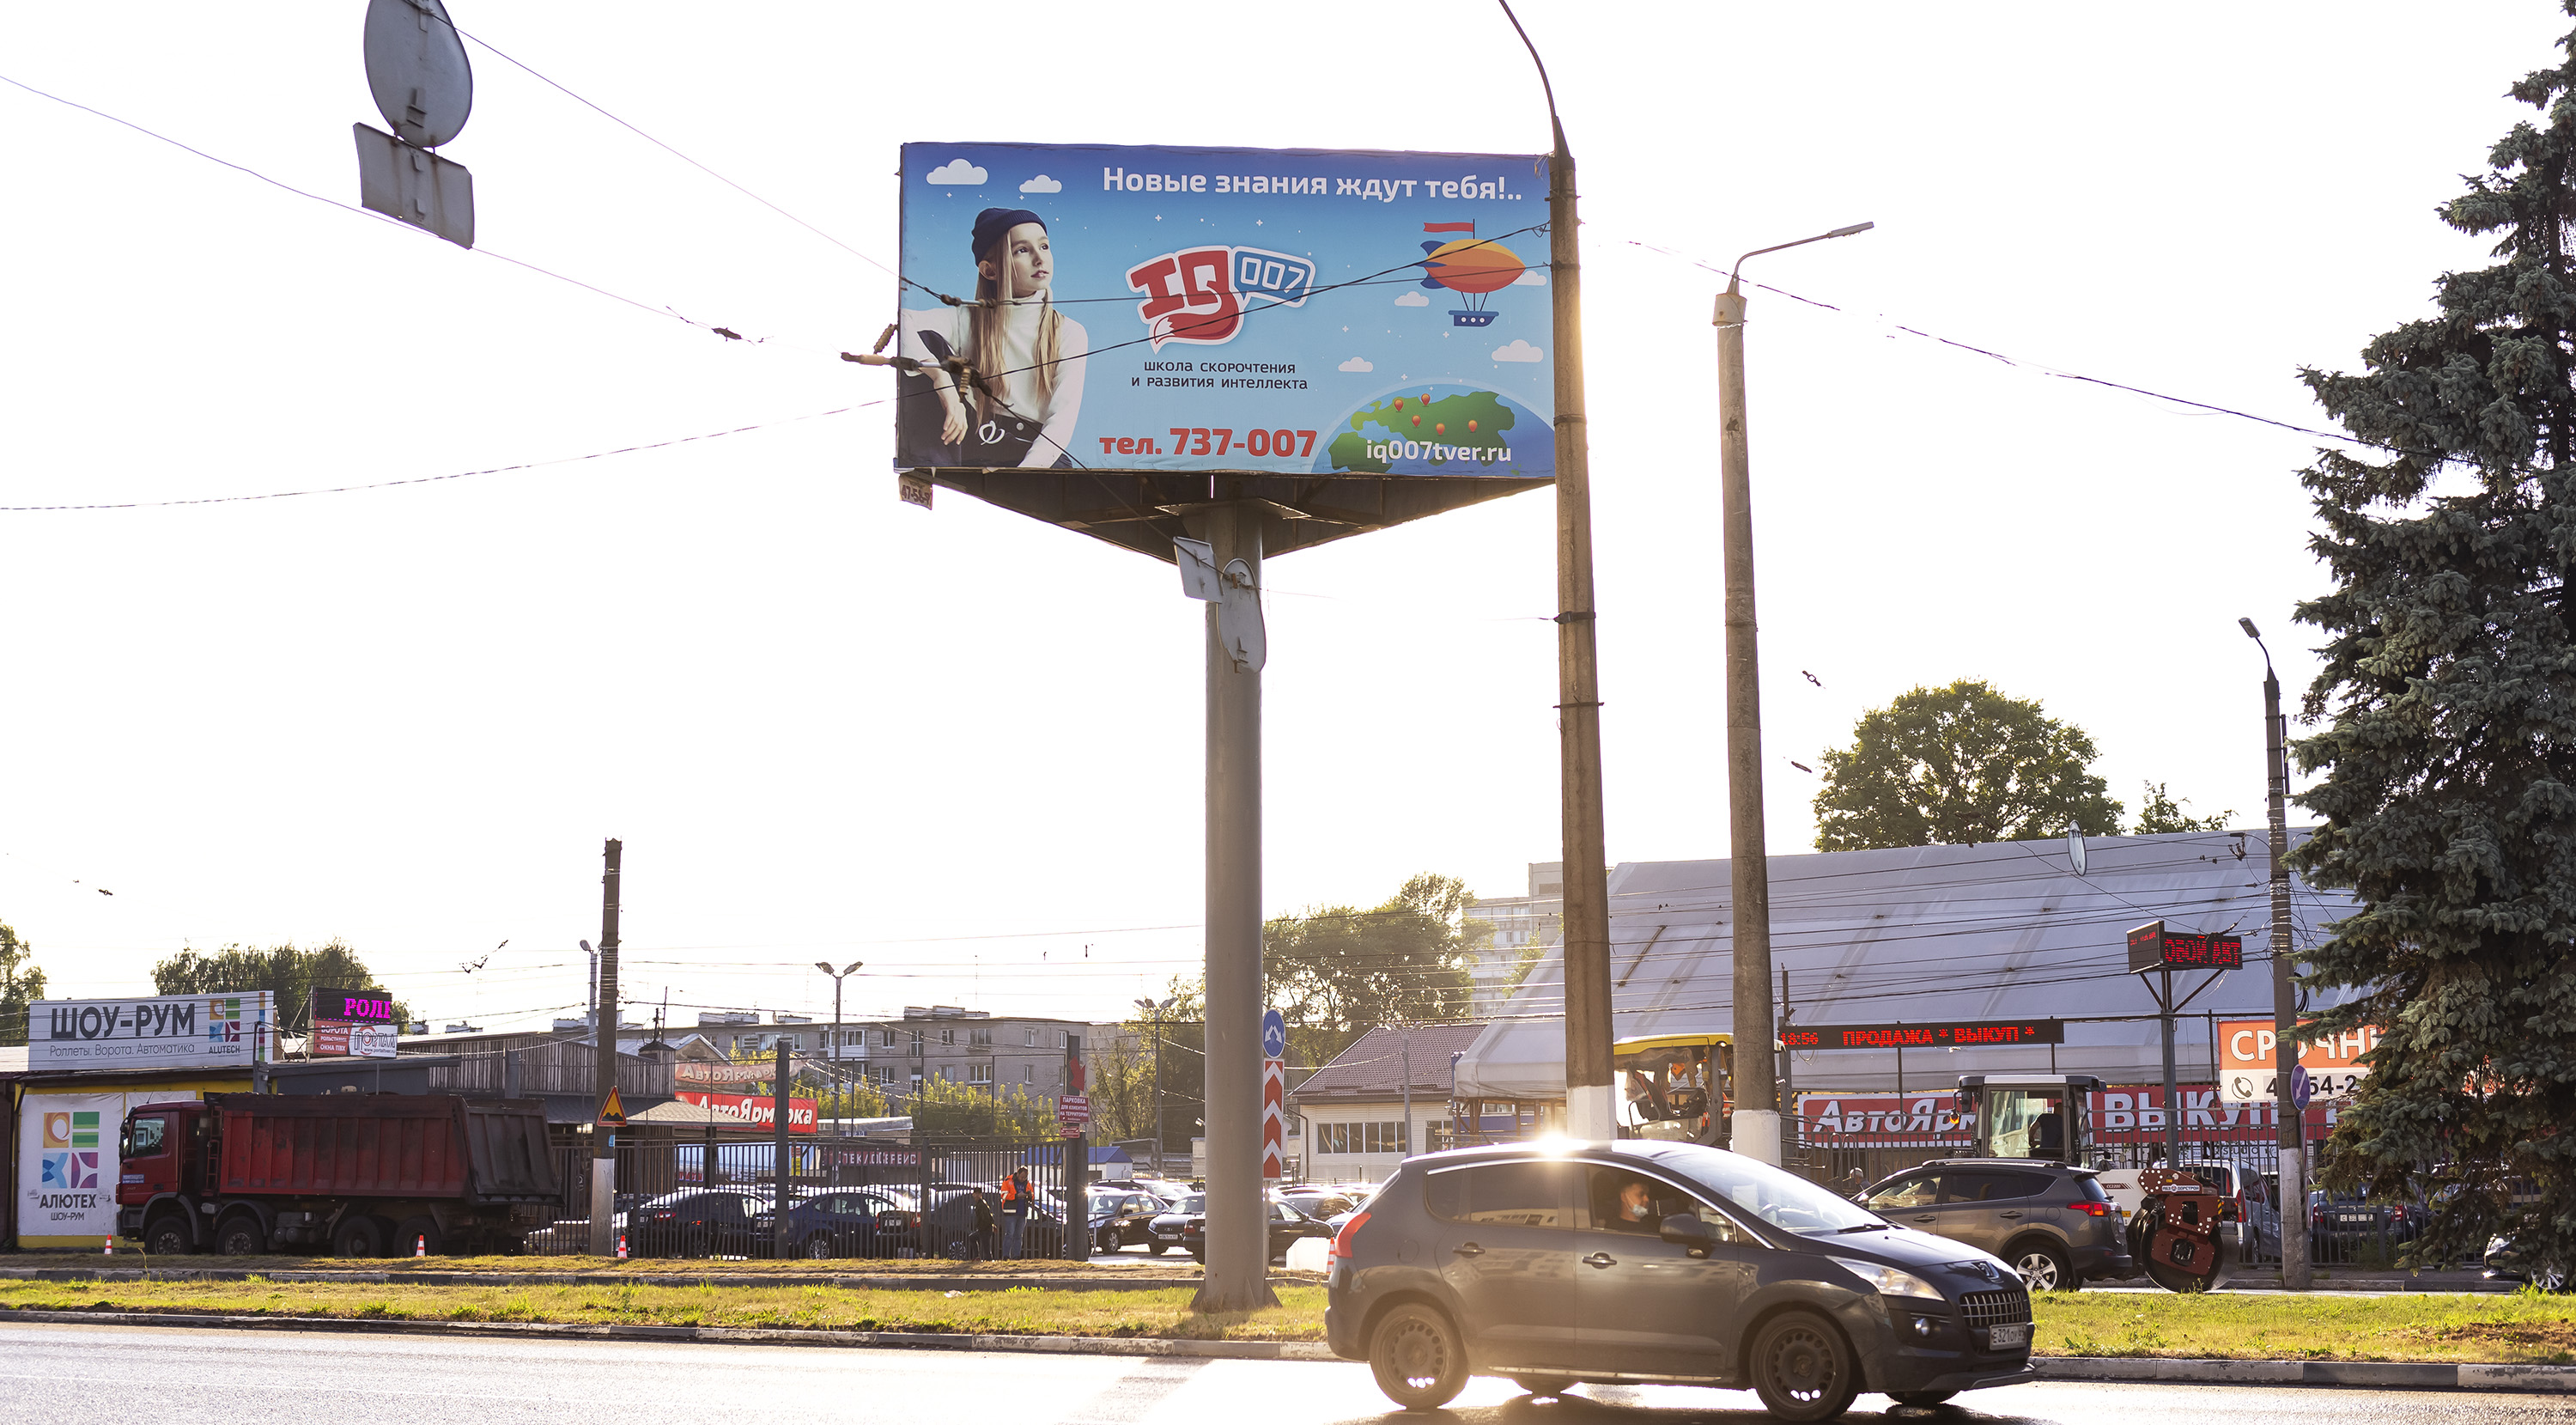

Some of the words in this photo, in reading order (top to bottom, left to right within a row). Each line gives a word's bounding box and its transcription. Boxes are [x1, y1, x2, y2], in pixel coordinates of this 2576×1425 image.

[1103, 167, 1207, 192] Новые
[1214, 174, 1327, 195] знания
[1335, 178, 1418, 204] ждут
[1424, 174, 1522, 200] тебя!..
[1129, 250, 1239, 344] IQ
[1240, 257, 1306, 294] 007
[1144, 361, 1194, 372] школа
[1200, 362, 1296, 374] скорочтения
[1131, 377, 1140, 387] и
[1147, 376, 1214, 387] развития
[1221, 378, 1308, 390] интеллекта
[1099, 437, 1163, 454] тел.
[1170, 428, 1318, 457] 737-007
[1366, 439, 1511, 464] iq007tver.ru
[51, 1003, 195, 1038] ШОУ-РУМ
[1843, 1029, 1934, 1047] ПРОДАЖА
[1953, 1026, 2019, 1043] ВЫКУП
[50, 1045, 92, 1057] Роллеты.
[94, 1044, 134, 1057] Ворота.
[137, 1043, 195, 1055] Автоматика
[209, 1044, 240, 1054] ALUTECH
[39, 1193, 97, 1209] АЛЮТЕХ
[51, 1212, 84, 1221] ШОУ-РУМ
